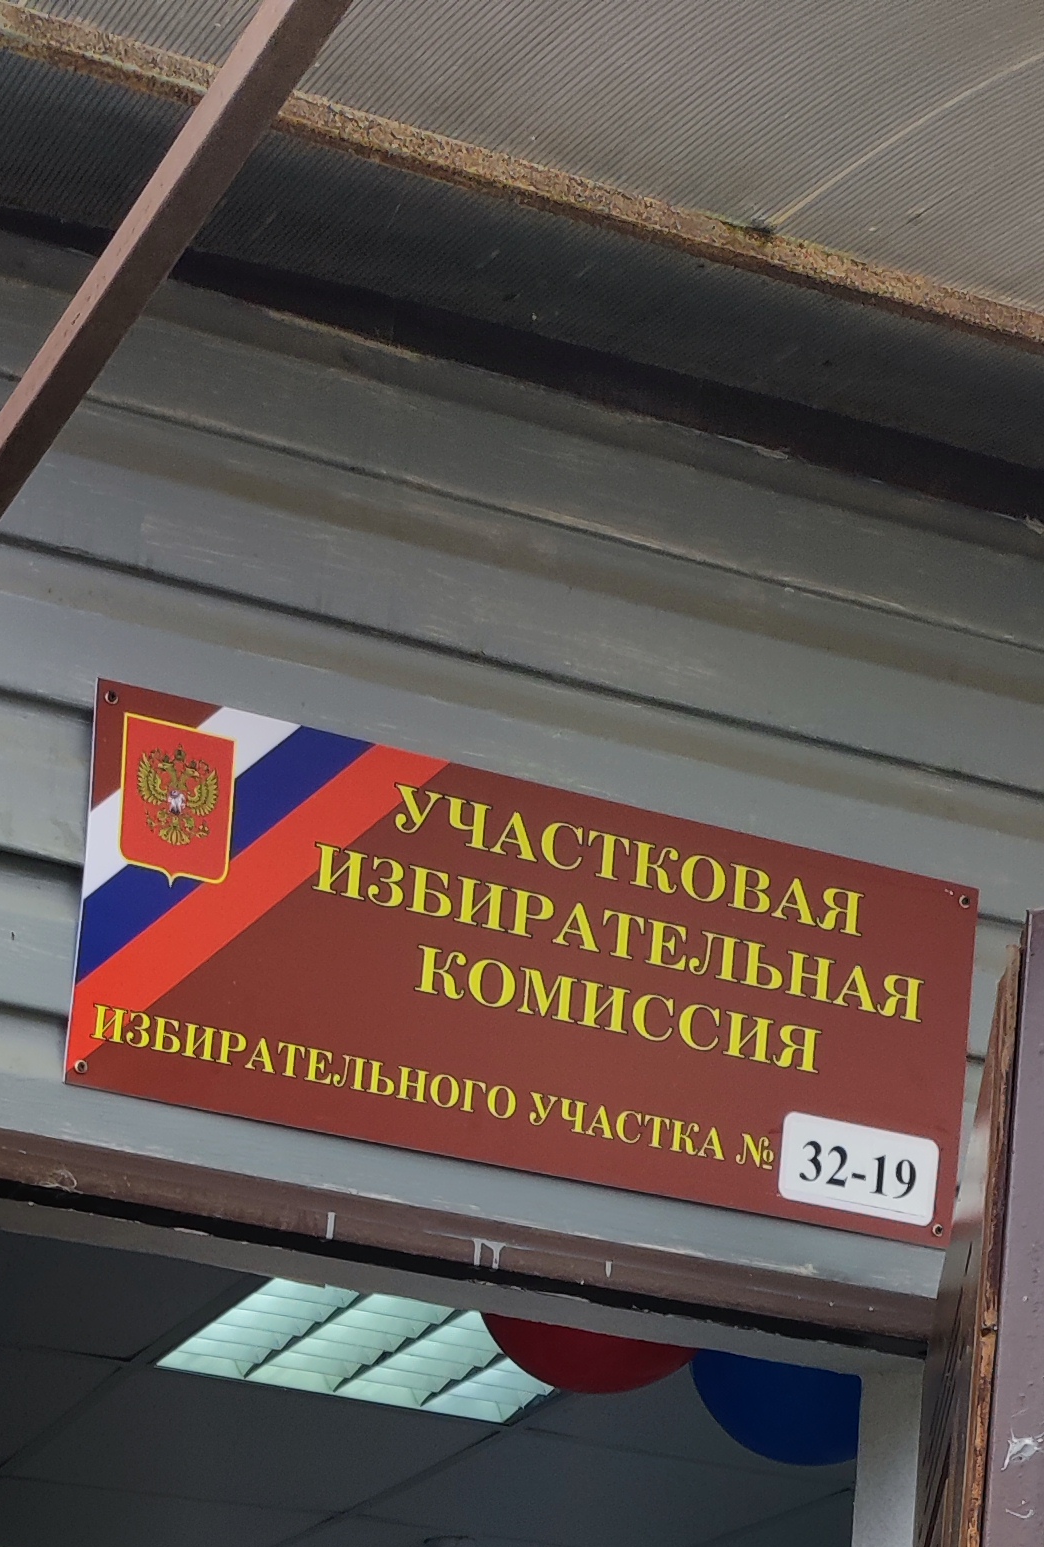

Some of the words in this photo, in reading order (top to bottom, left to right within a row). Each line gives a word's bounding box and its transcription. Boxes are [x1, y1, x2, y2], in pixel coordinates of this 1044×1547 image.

[311, 842, 924, 1023] ИЗБИРАТЕЛЬНАЯ
[394, 782, 864, 937] УЧАСТКОВАЯ
[415, 944, 822, 1074] КОМИССИЯ
[89, 1003, 518, 1120] ИЗБИРАТЕЛЬНОГО
[528, 1091, 725, 1161] УЧАСТКА
[735, 1133, 775, 1170] №
[799, 1140, 917, 1200] 32-19
